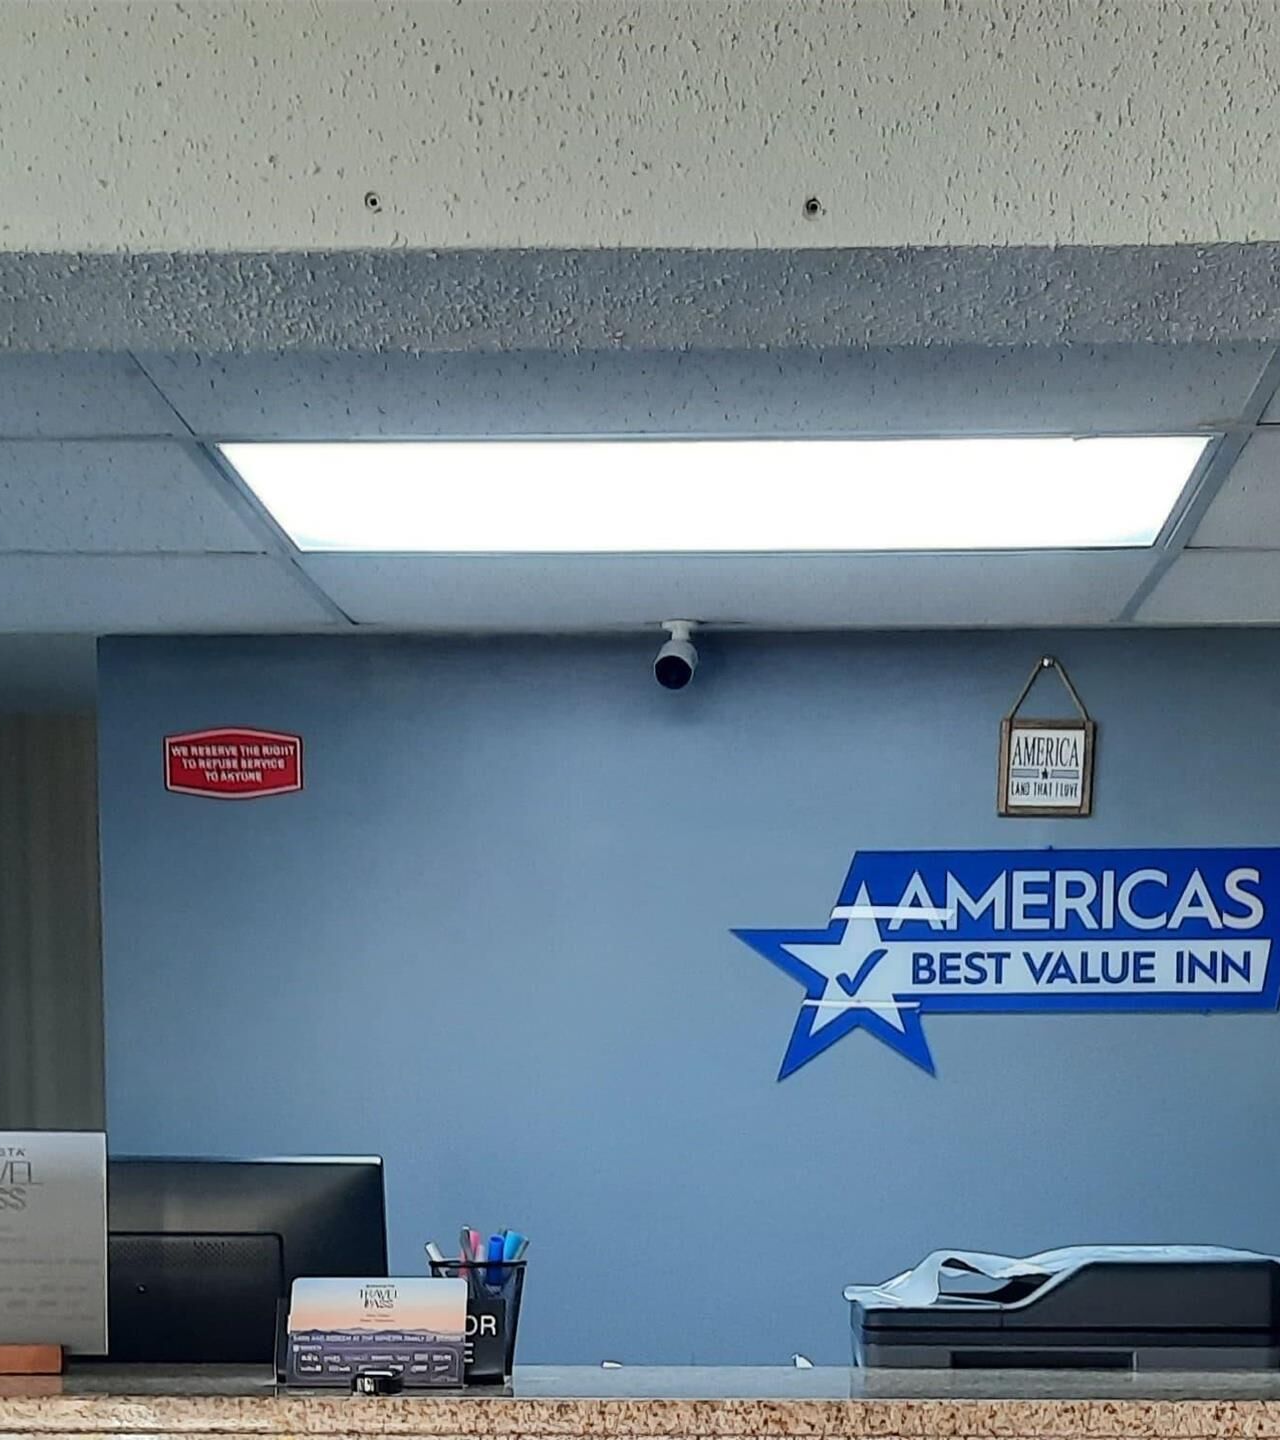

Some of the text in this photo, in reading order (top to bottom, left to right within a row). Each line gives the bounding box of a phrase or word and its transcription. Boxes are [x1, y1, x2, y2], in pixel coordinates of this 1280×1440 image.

[171, 745, 295, 757] WE RESERVE THE RIGHT
[1012, 736, 1080, 768] AMERICA
[182, 759, 285, 770] TO REFUSE SERVICE
[205, 771, 263, 783] TO ANYONE
[1011, 780, 1030, 797] LAND
[1034, 781, 1053, 798] THAT
[1060, 782, 1078, 798] LOVE
[888, 867, 1265, 931] AMERICAS
[911, 950, 1251, 985] BEST VALUE INN
